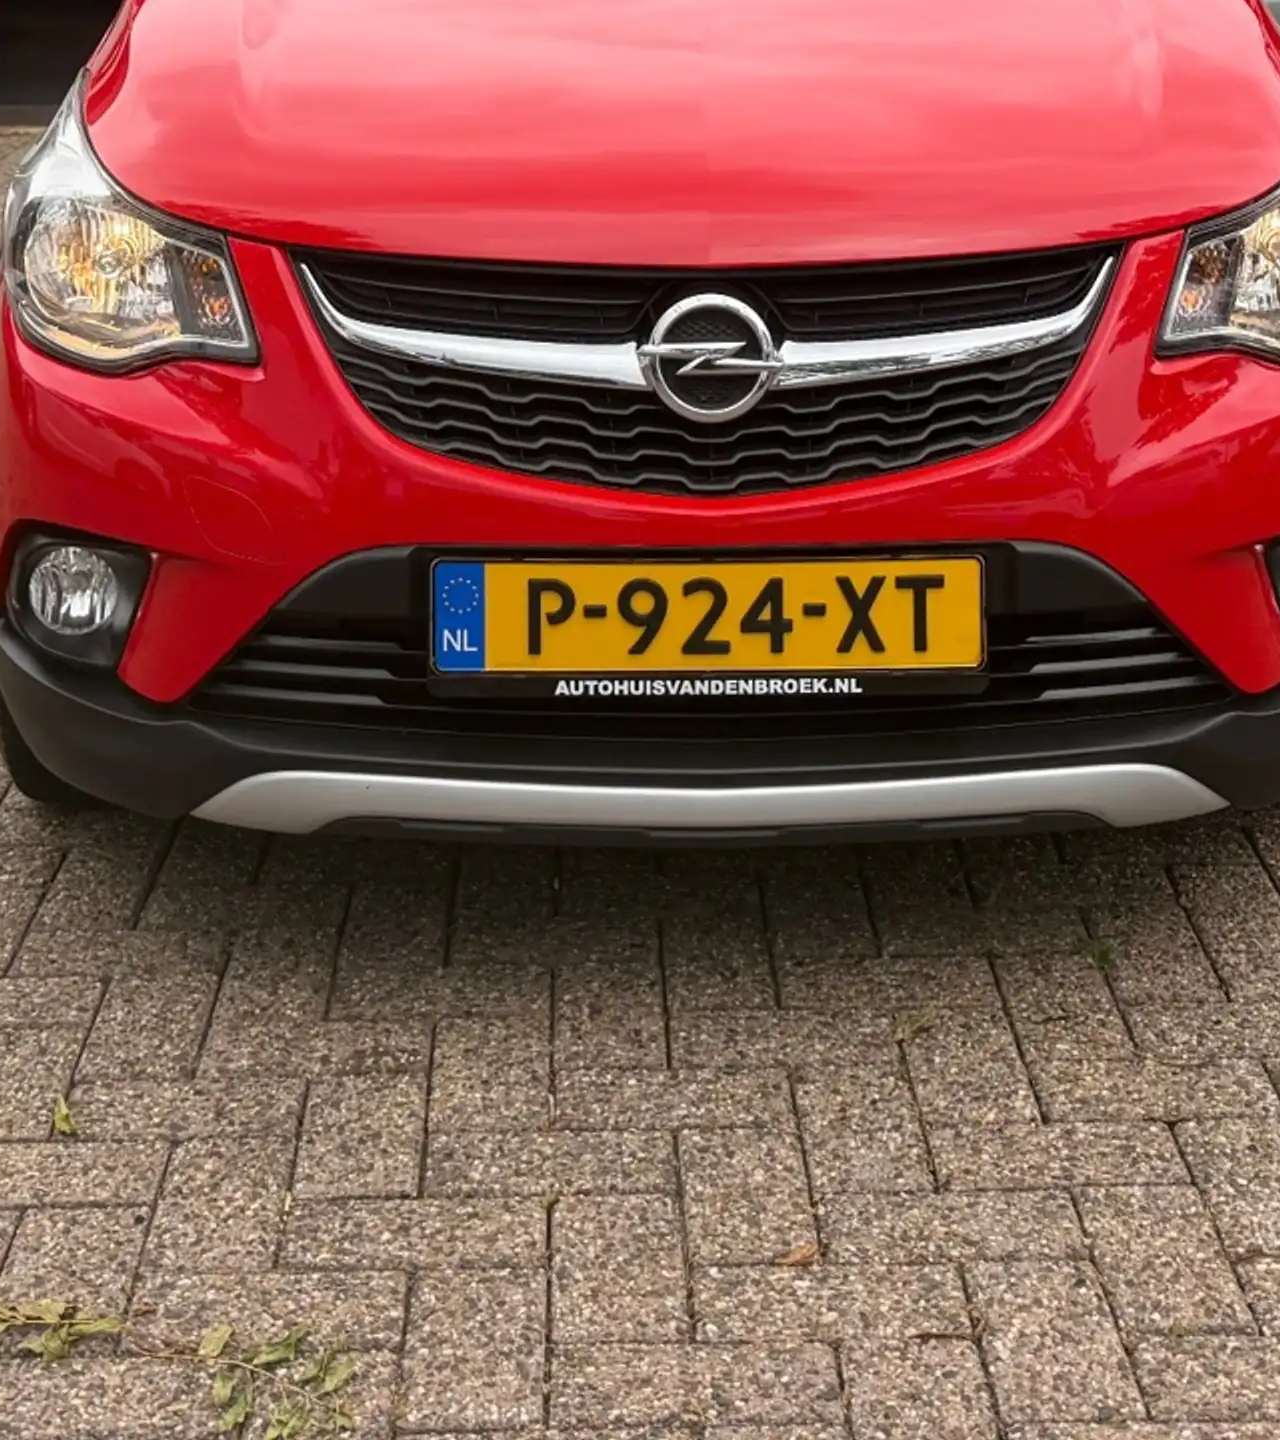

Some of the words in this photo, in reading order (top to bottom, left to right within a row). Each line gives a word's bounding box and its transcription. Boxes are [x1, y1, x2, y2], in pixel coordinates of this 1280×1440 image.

[527, 573, 946, 656] P-924-XT
[442, 629, 478, 653] NL
[554, 676, 863, 697] AUTOHUISVANDENBROEK.NL
